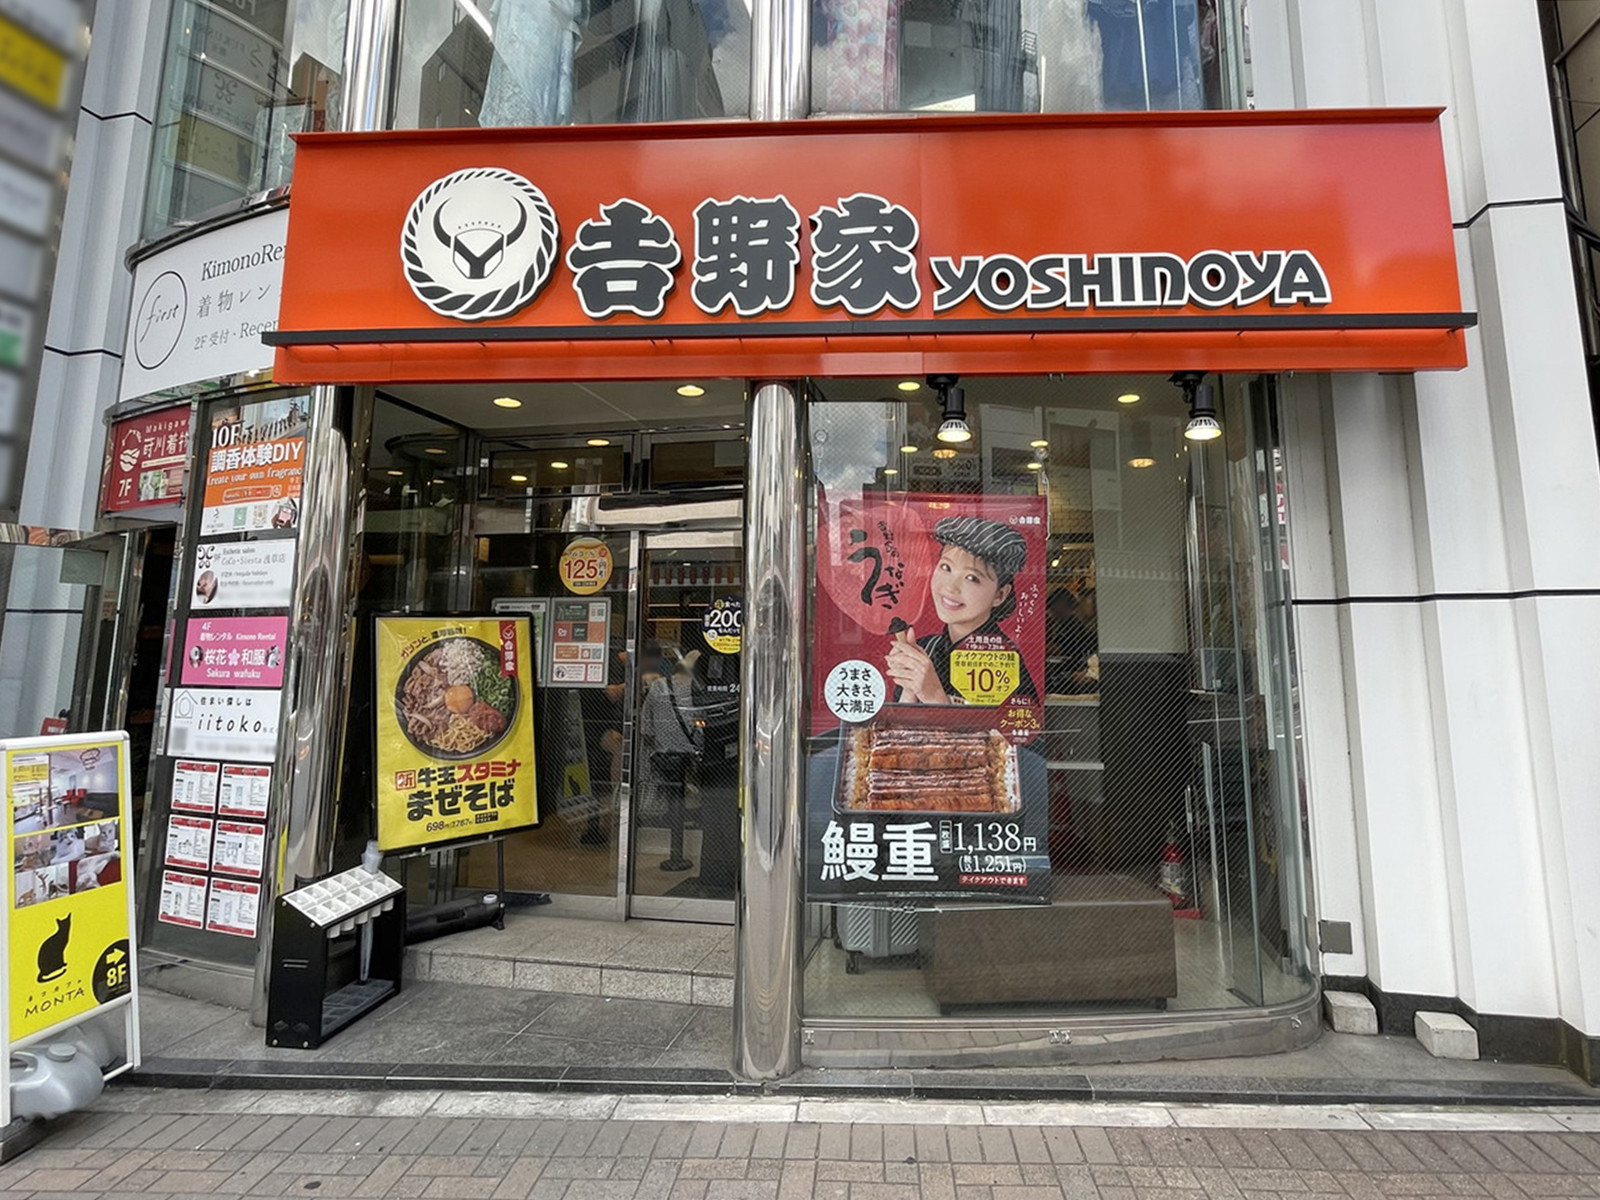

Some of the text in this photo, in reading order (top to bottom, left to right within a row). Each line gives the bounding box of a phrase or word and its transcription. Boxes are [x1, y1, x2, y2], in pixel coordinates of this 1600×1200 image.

[566, 192, 921, 318] 吉野家
[929, 249, 1332, 311] YOSHINOYA
[140, 294, 179, 343] first
[211, 424, 241, 449] 10F
[118, 478, 133, 498] 7F
[564, 558, 598, 579] 125
[838, 666, 873, 682] うまさ
[966, 668, 1010, 692] 10%
[835, 699, 876, 715] 大満足
[198, 713, 262, 733] iitoko
[417, 758, 522, 788] 牛玉スタミナ
[407, 778, 515, 821] まぜそば
[820, 820, 940, 882] 鰻重
[106, 963, 127, 987] 8F
[25, 987, 85, 1019] MONTA
